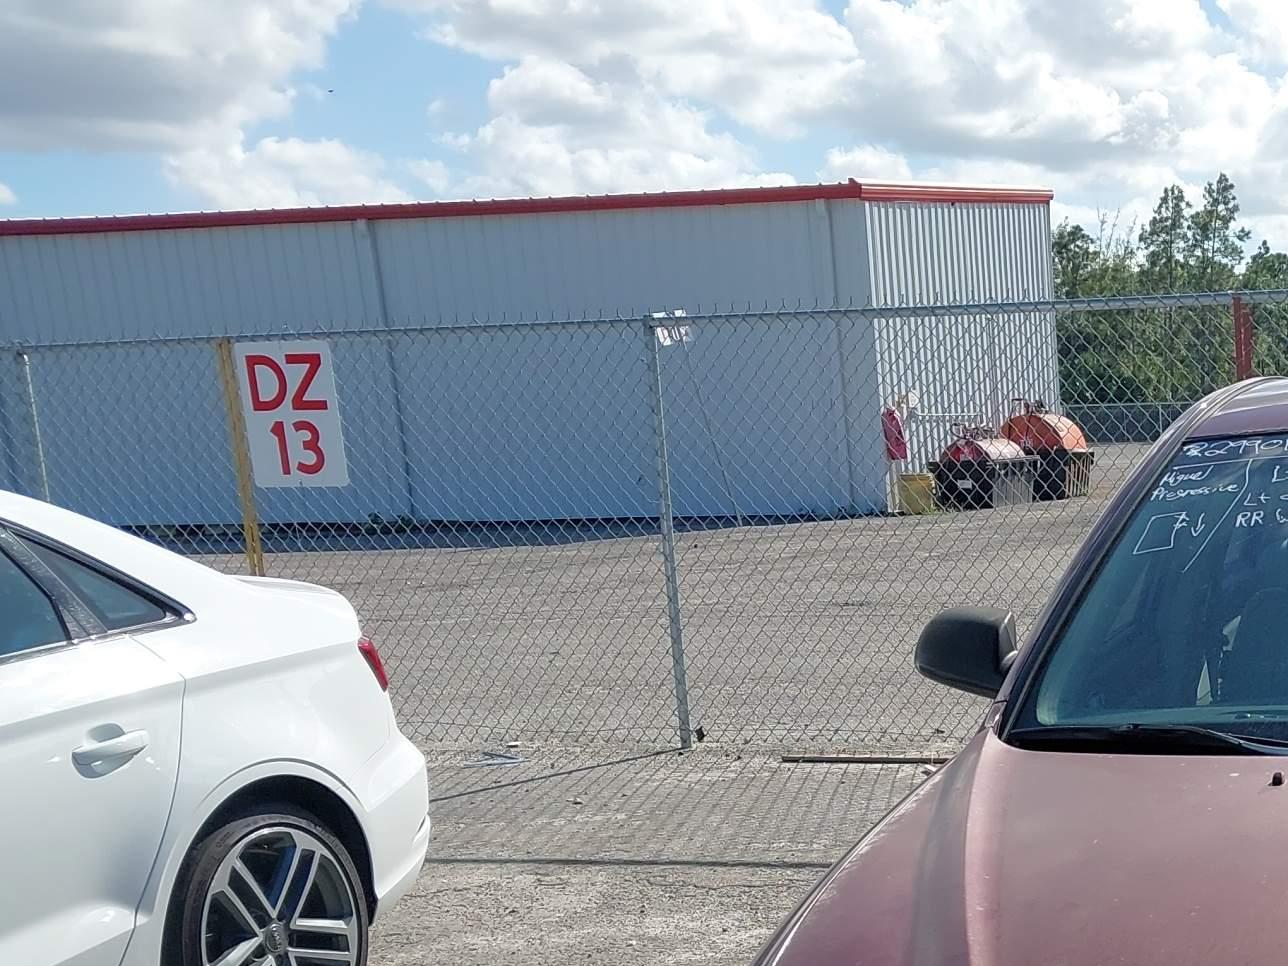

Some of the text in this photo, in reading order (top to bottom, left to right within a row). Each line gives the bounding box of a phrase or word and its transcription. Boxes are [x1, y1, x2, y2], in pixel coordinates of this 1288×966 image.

[245, 354, 328, 411] DZ
[270, 420, 325, 475] 13
[1235, 511, 1264, 527] RR
